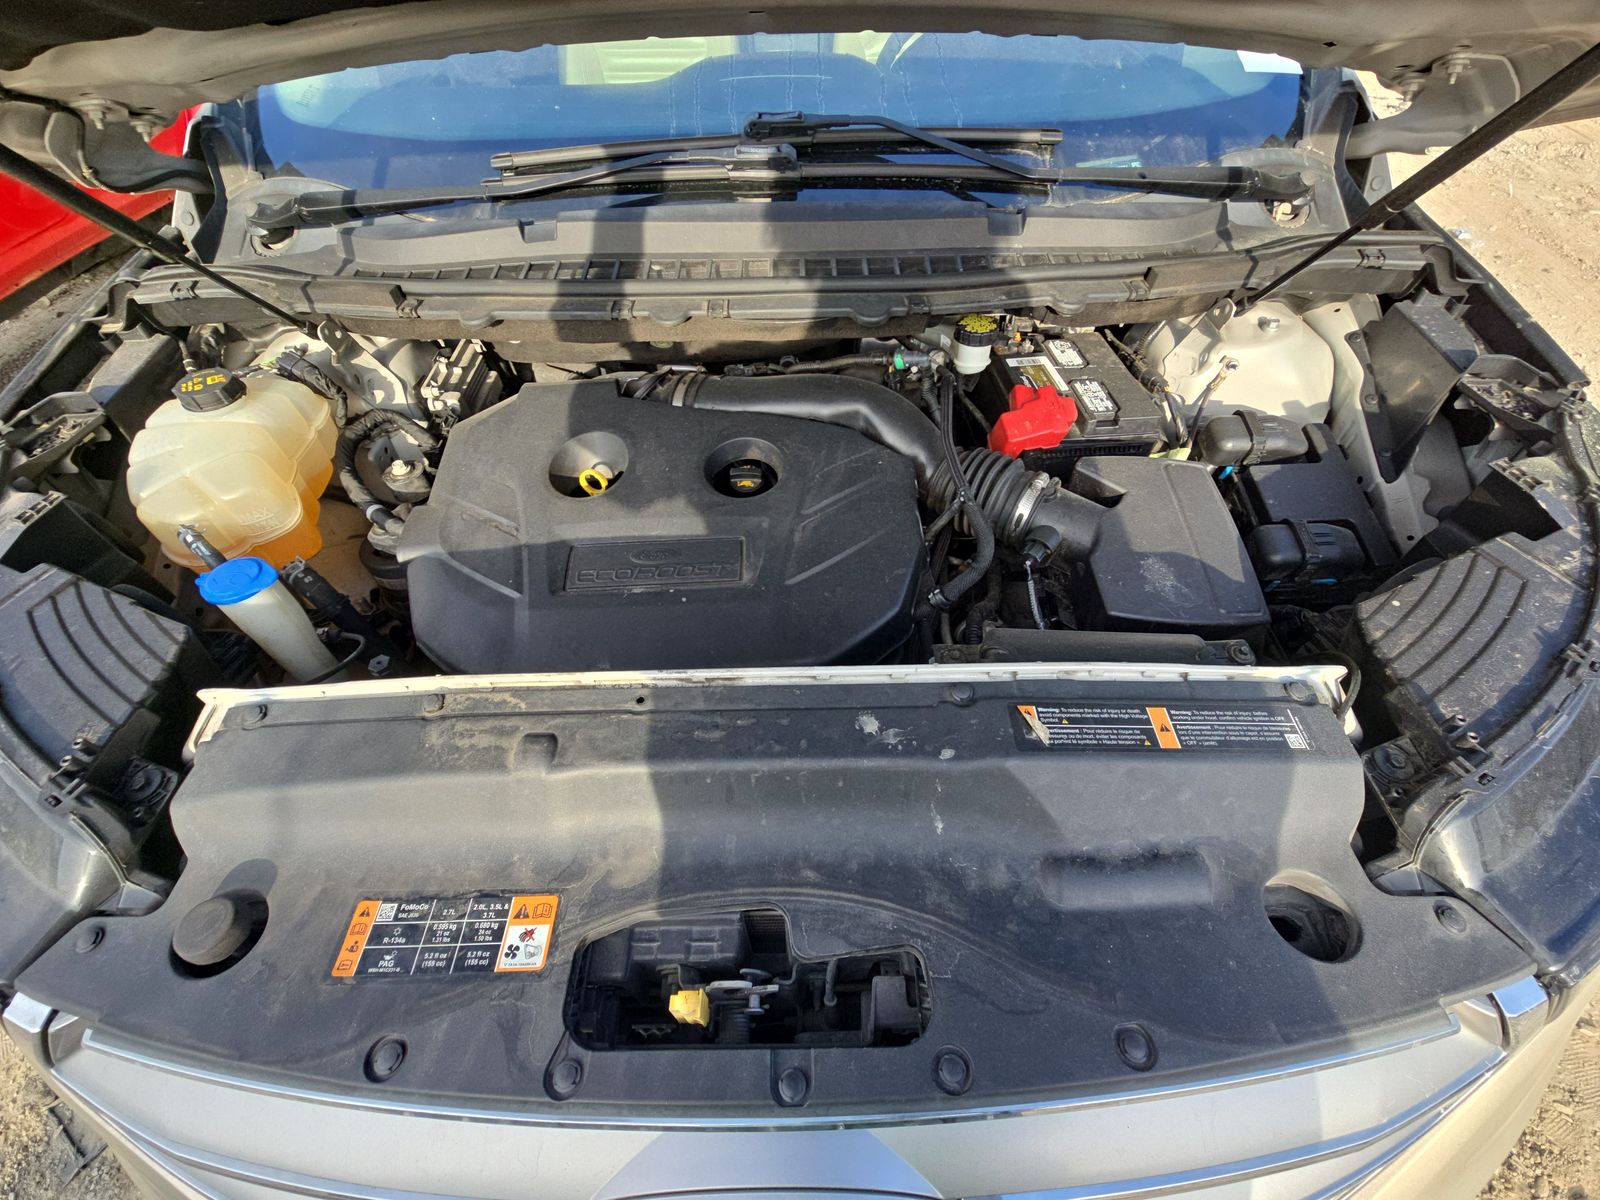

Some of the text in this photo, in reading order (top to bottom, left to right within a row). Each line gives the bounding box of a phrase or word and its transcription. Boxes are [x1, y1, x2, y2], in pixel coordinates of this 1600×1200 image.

[400, 903, 429, 911] FoMoCo
[433, 922, 457, 931] 0.595 kg
[474, 921, 499, 929] 0.680 kg
[467, 950, 477, 958] 5.2
[378, 960, 395, 968] PAG
[421, 960, 435, 968] (155
[465, 958, 489, 967] (155 cc)
